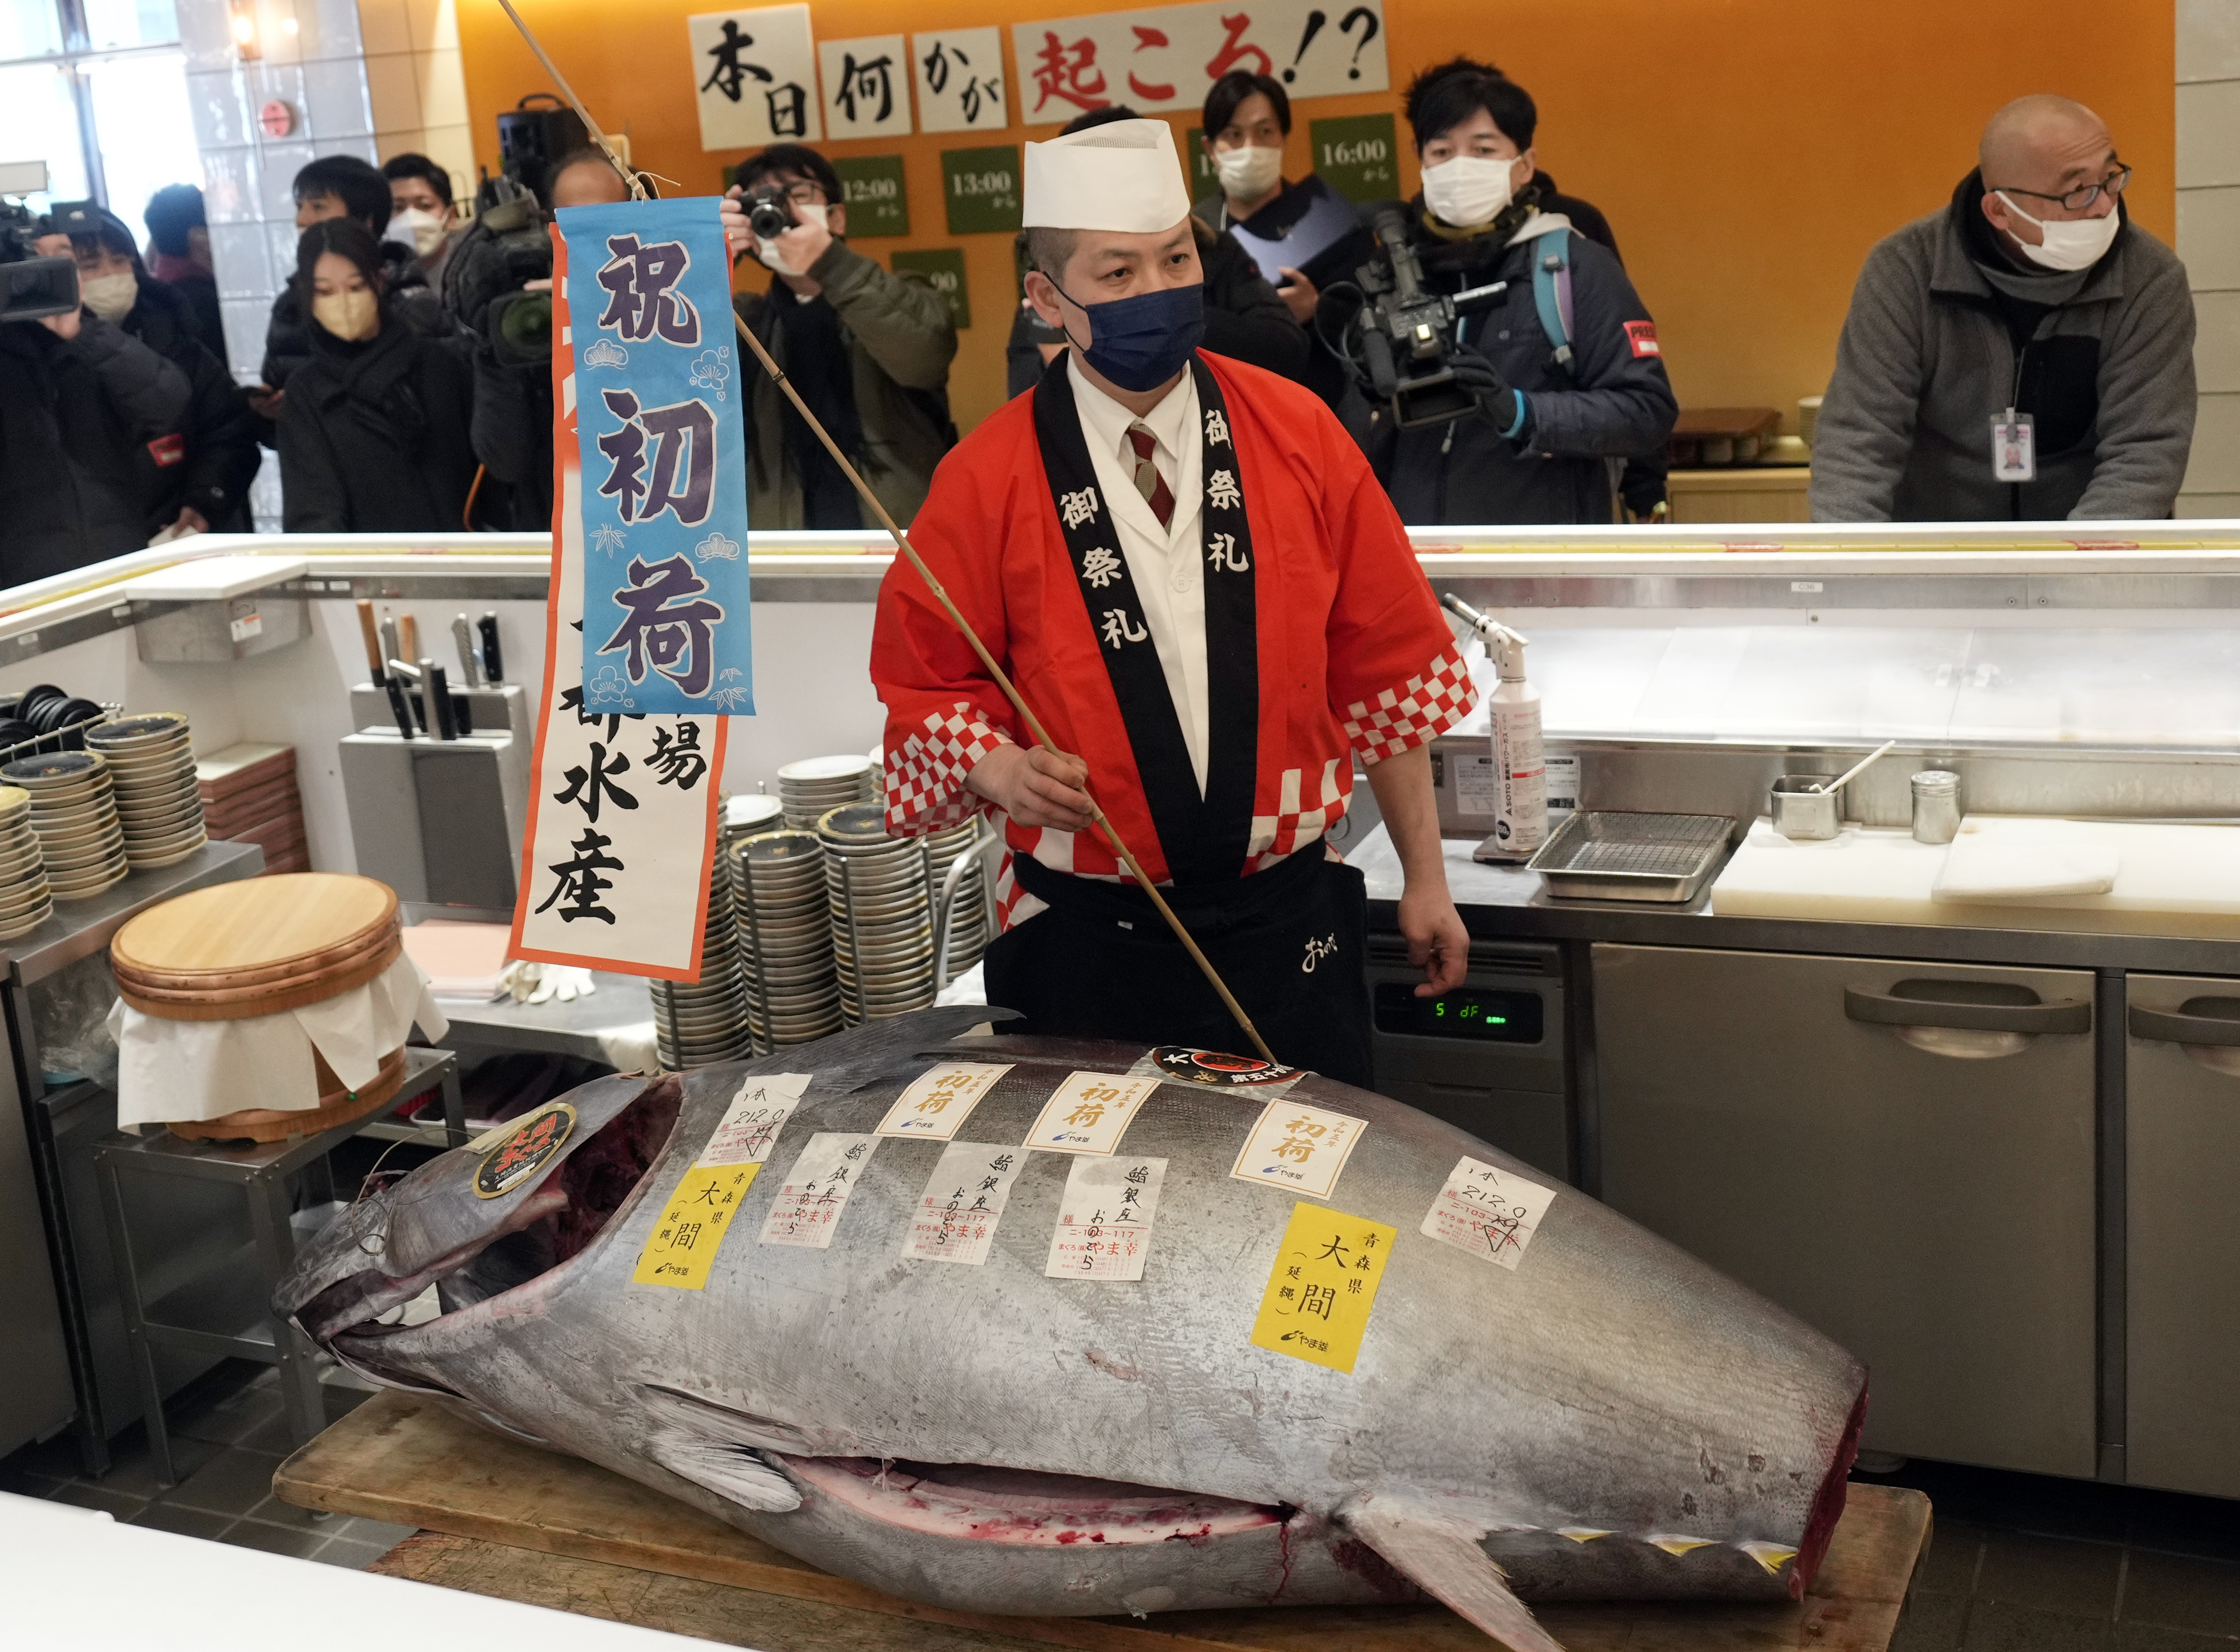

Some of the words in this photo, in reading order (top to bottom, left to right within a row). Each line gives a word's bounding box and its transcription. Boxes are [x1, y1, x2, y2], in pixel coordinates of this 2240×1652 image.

[702, 19, 807, 138] 本日
[835, 51, 894, 122] 何
[924, 41, 1000, 124] かが
[1323, 139, 1387, 166] 16:00
[844, 177, 898, 202] 12:00
[953, 170, 1011, 197] 13:00
[595, 233, 725, 698] 祝初荷
[1059, 486, 1148, 649] 御祭礼
[914, 1070, 973, 1114] 初荷
[1062, 1082, 1120, 1127] 初荷
[1271, 1115, 1327, 1163] 初荷
[670, 1180, 721, 1251] 大間
[710, 1172, 746, 1224] 青森県
[1462, 1185, 1527, 1218] 212.0
[1298, 1235, 1350, 1321] 大間
[1347, 1232, 1380, 1294] 青森県
[1299, 1335, 1329, 1352] やま幸
